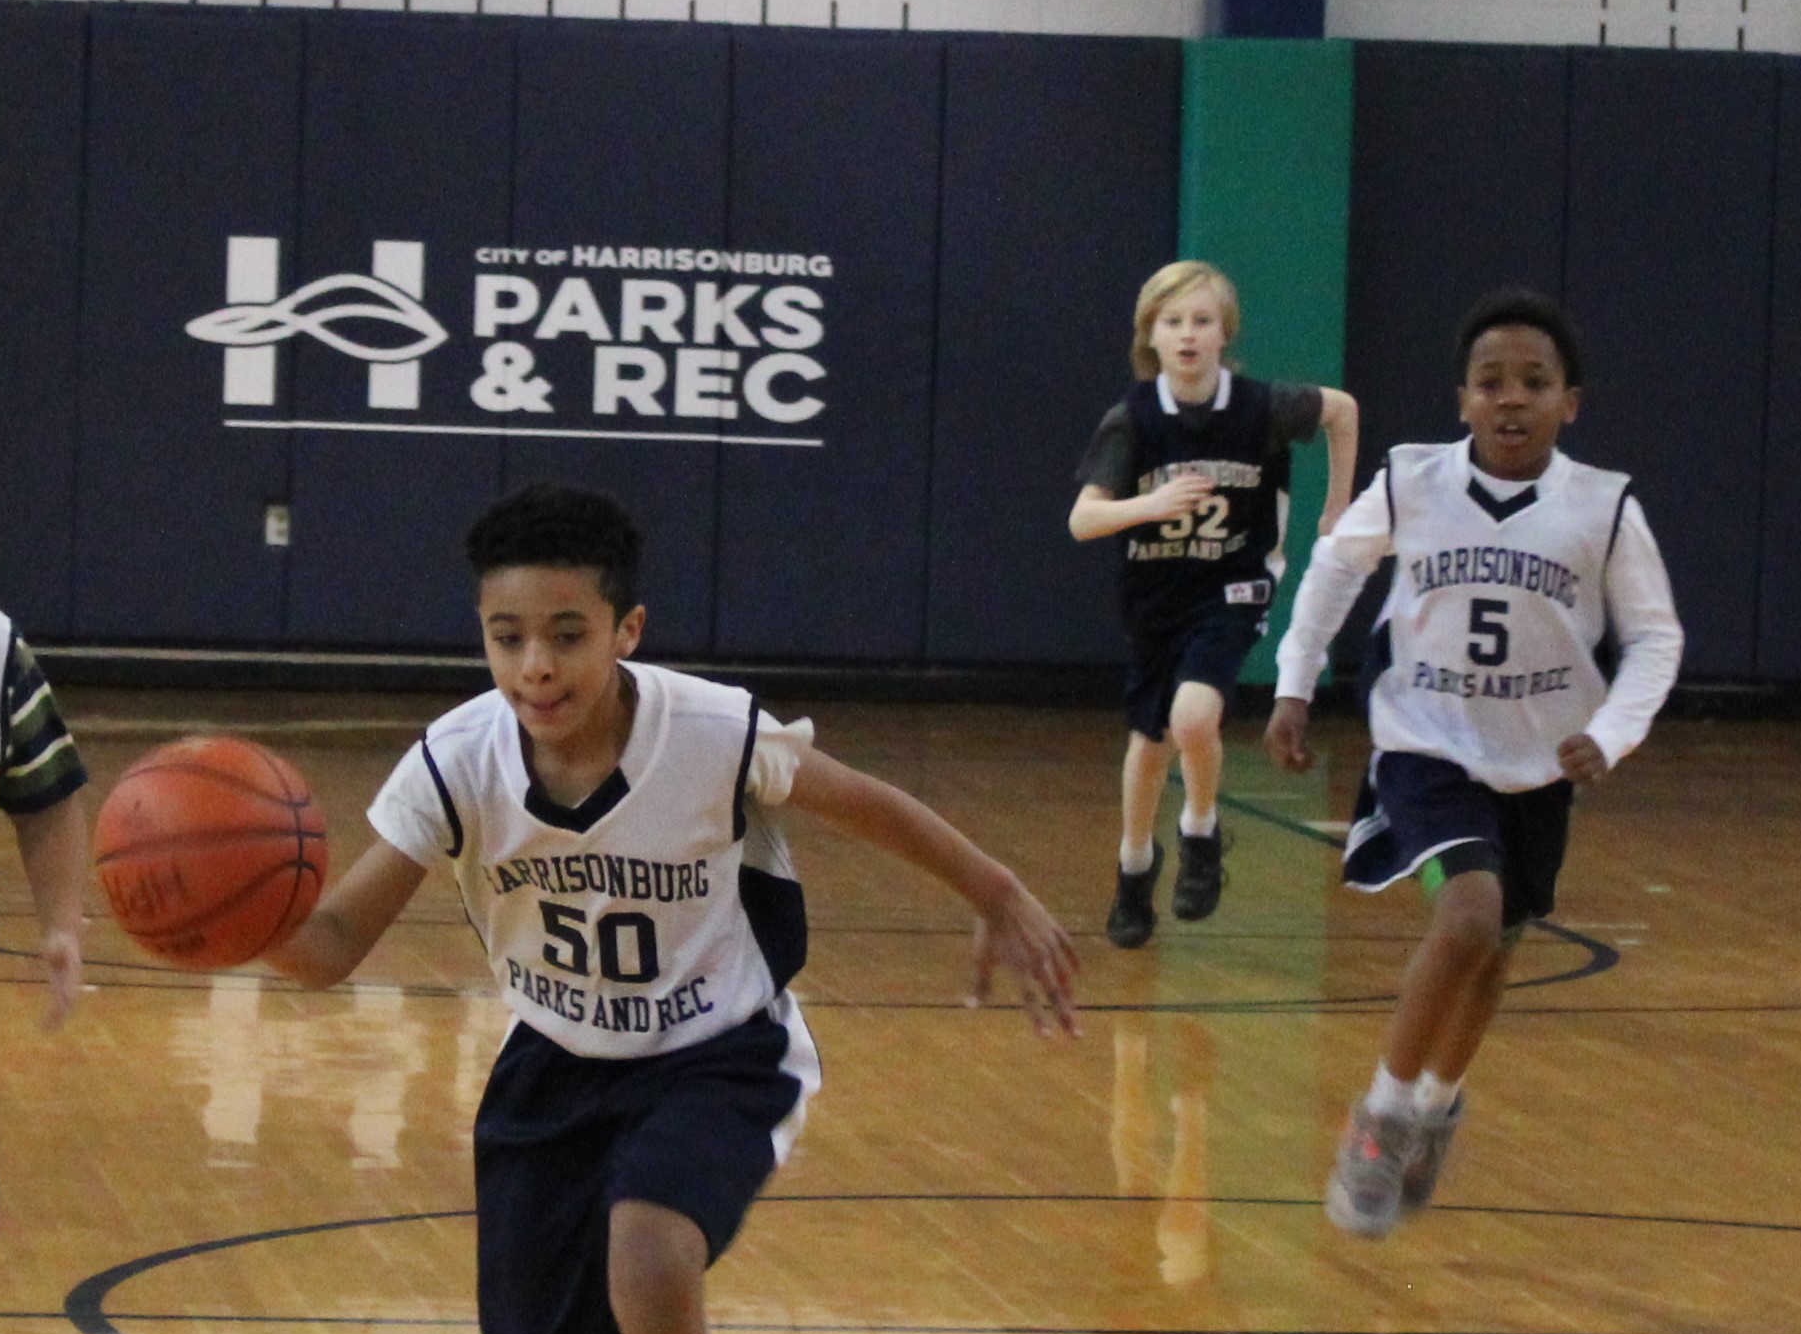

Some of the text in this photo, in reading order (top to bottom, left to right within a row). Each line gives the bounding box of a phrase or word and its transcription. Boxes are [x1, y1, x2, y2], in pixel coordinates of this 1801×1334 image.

[475, 245, 833, 277] CITY OF HARRISONBURG
[474, 274, 825, 349] PARKS
[469, 341, 827, 423] & REC
[1467, 598, 1509, 667] 5
[538, 900, 660, 984] 50
[506, 957, 713, 1033] PARKS AND REC
